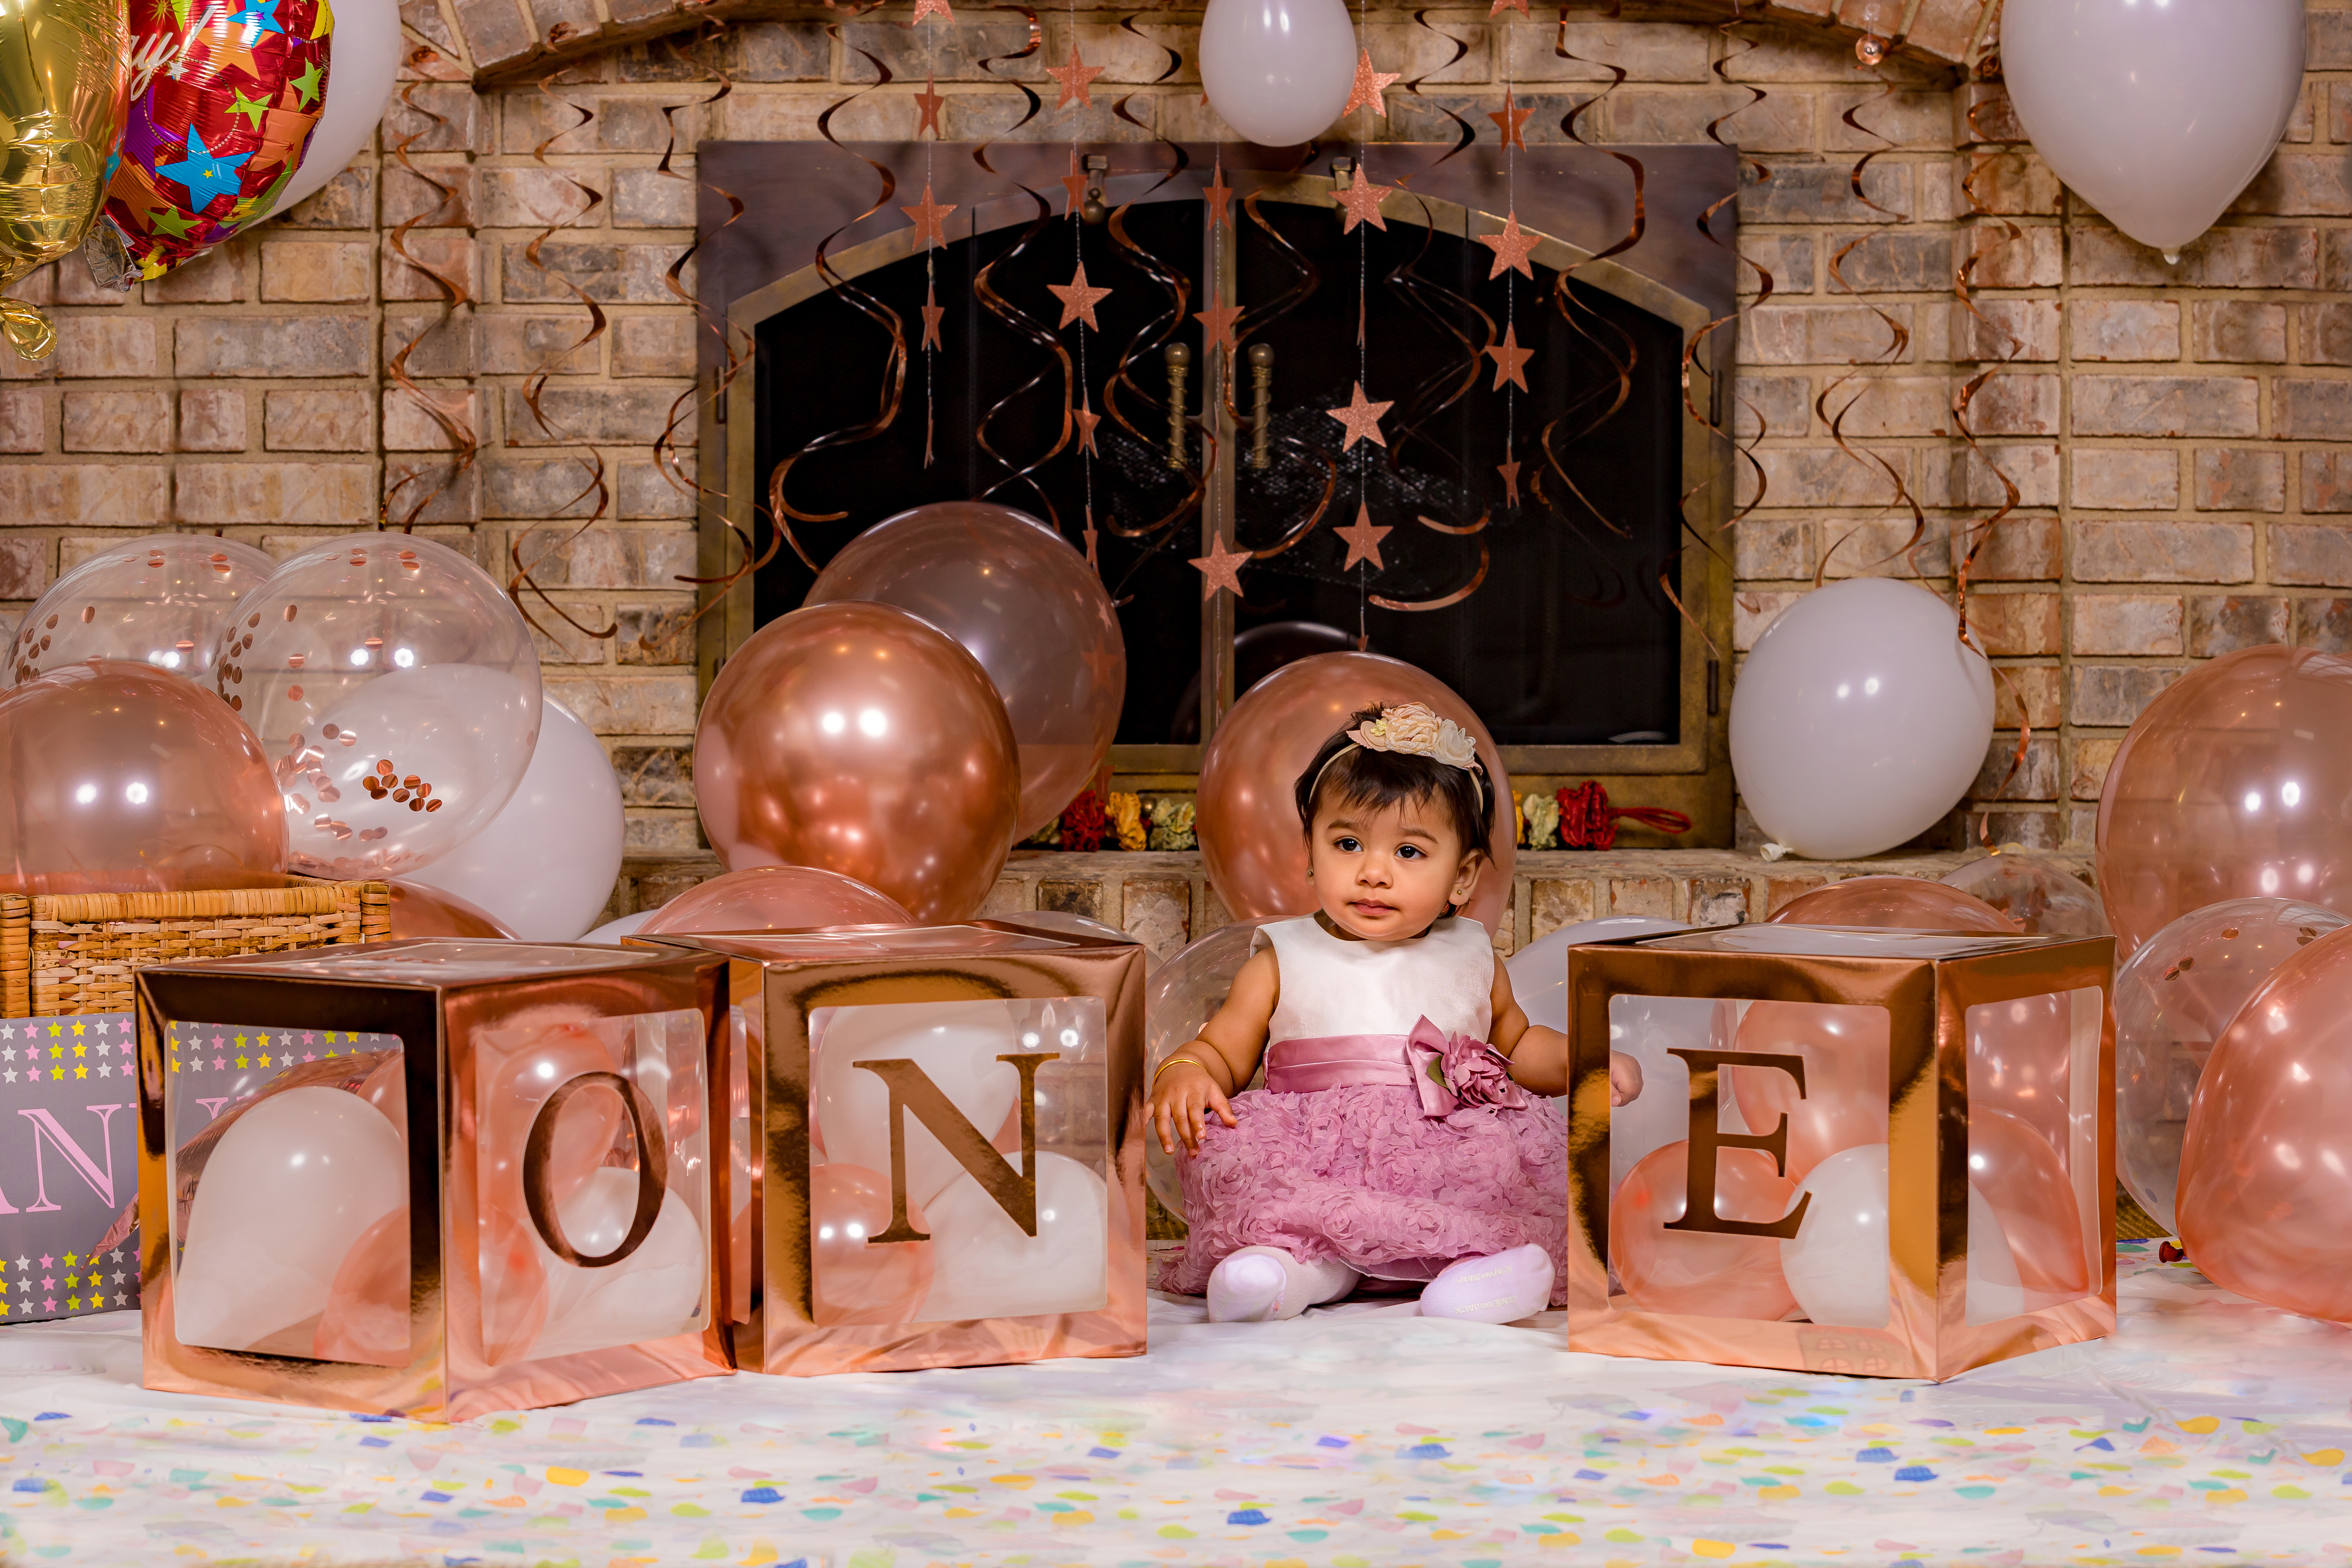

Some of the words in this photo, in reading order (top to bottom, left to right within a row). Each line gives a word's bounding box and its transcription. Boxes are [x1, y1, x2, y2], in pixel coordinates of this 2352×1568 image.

[523, 1070, 666, 1268] O
[853, 1052, 1060, 1244] N
[1663, 1047, 1812, 1240] E
[1454, 1303, 1479, 1314] JACK
[1456, 1273, 1481, 1283] JANIE
[1492, 1265, 1513, 1277] JACK
[1493, 1295, 1516, 1308] JANIE
